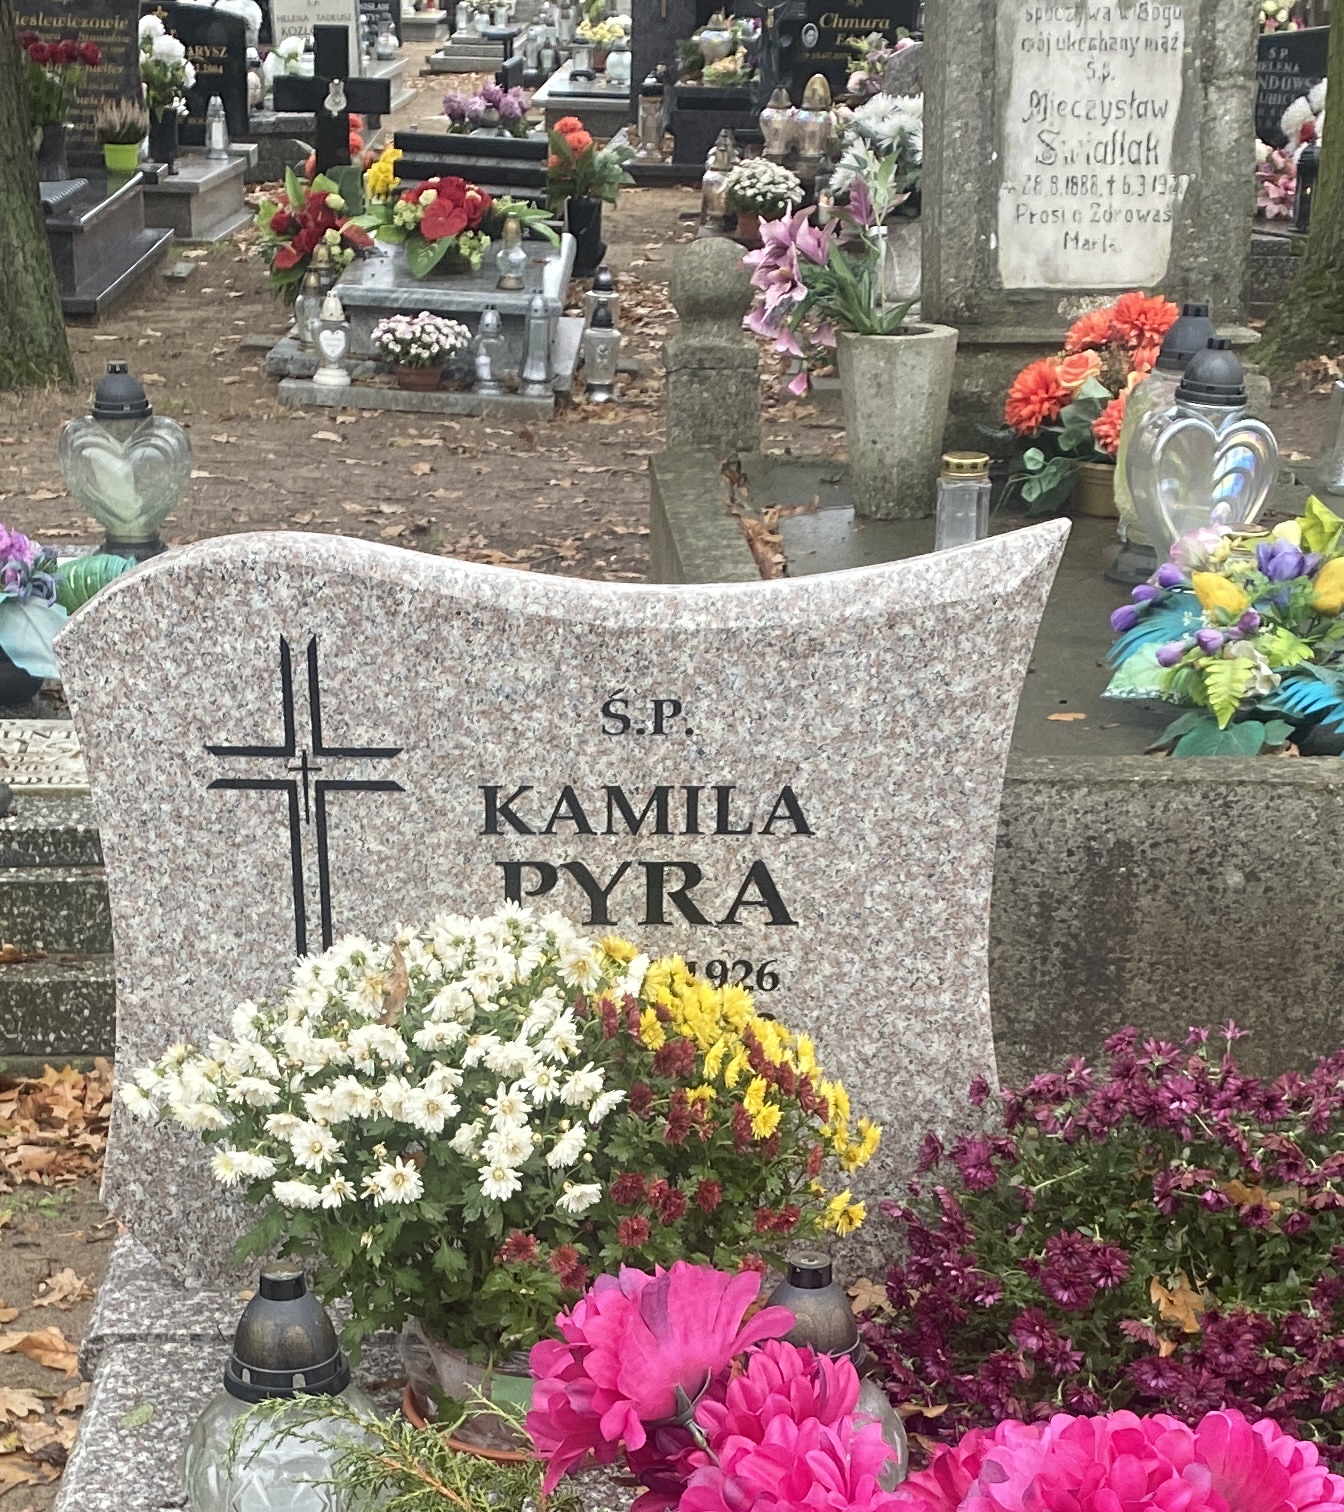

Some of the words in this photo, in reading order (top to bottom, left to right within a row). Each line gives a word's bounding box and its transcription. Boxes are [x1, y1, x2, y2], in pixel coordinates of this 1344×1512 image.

[819, 12, 892, 31] Chmura
[187, 45, 228, 58] ARYSZ
[600, 687, 695, 736] Ś.P.
[478, 784, 816, 836] KAMILA
[495, 858, 799, 927] PYRA
[686, 959, 781, 993] 926
